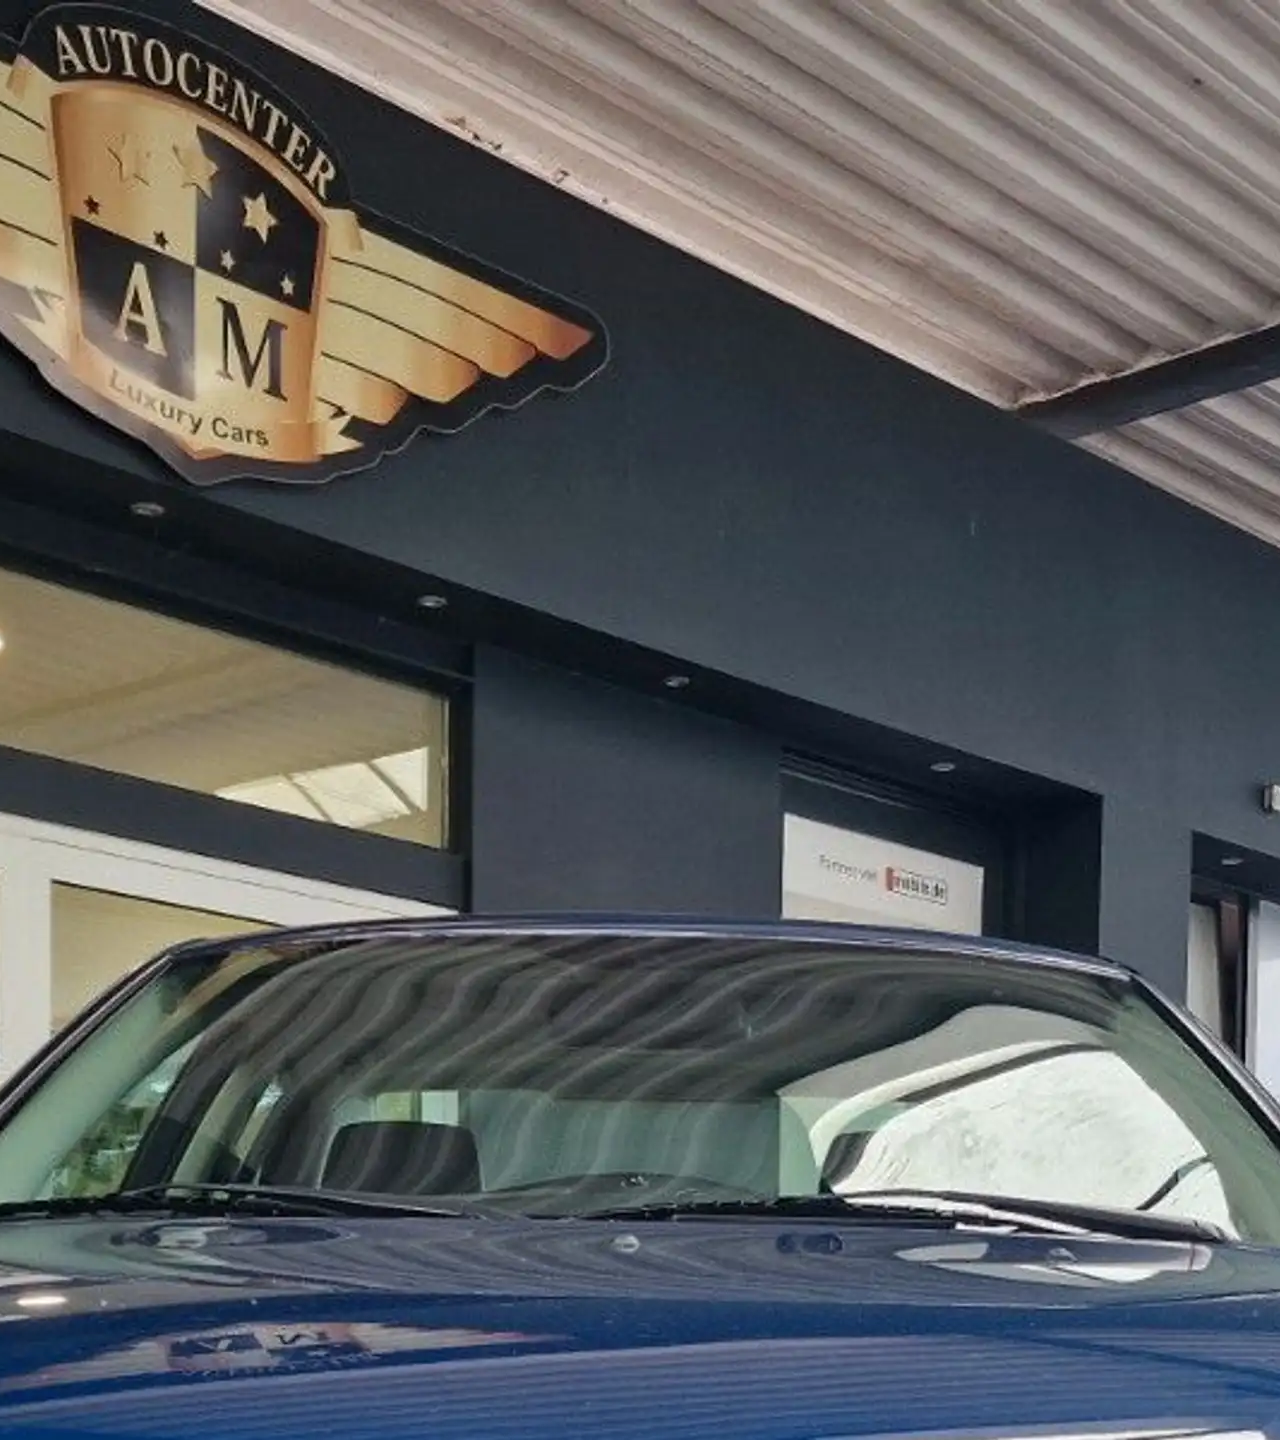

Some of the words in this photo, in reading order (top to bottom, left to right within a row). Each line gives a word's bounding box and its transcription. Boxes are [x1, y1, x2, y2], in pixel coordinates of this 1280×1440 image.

[55, 24, 336, 200] AUTOCENTER
[114, 262, 168, 357] A
[216, 296, 288, 402] M
[109, 368, 203, 435] Luxury
[211, 417, 269, 447] Cars
